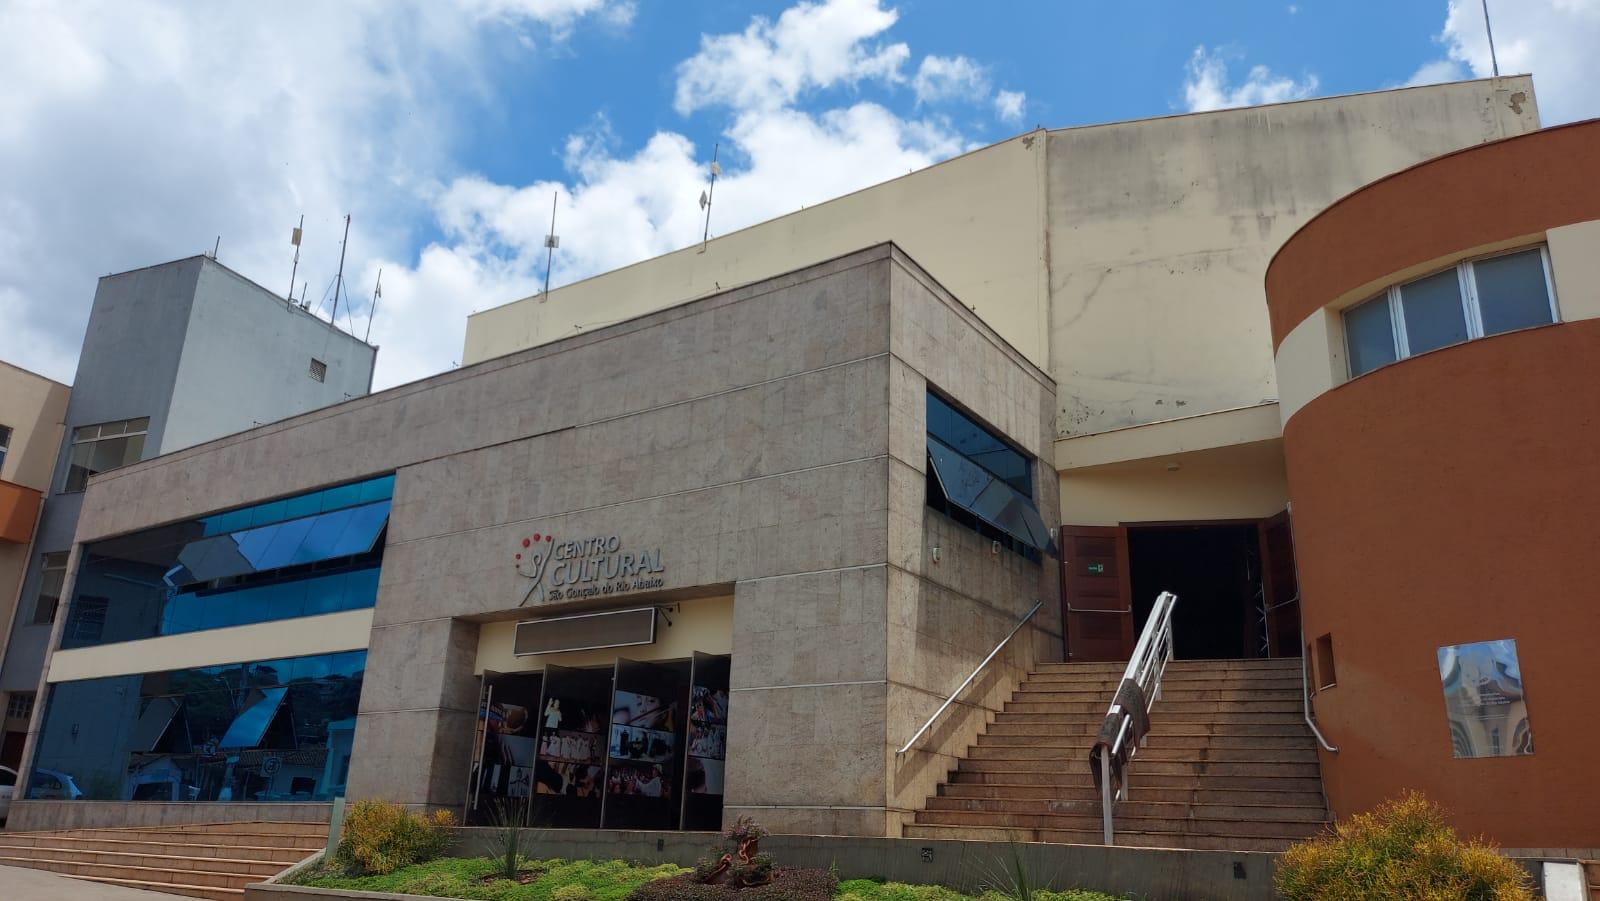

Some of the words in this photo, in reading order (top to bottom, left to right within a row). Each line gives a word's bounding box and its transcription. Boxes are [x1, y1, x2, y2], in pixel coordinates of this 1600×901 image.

[555, 535, 621, 561] CENTRO
[552, 548, 665, 587] CULTURAL
[548, 590, 563, 601] São
[566, 585, 600, 600] Gonçalo
[602, 583, 614, 594] do
[616, 581, 630, 593] Rio
[633, 576, 664, 591] Abaixo
